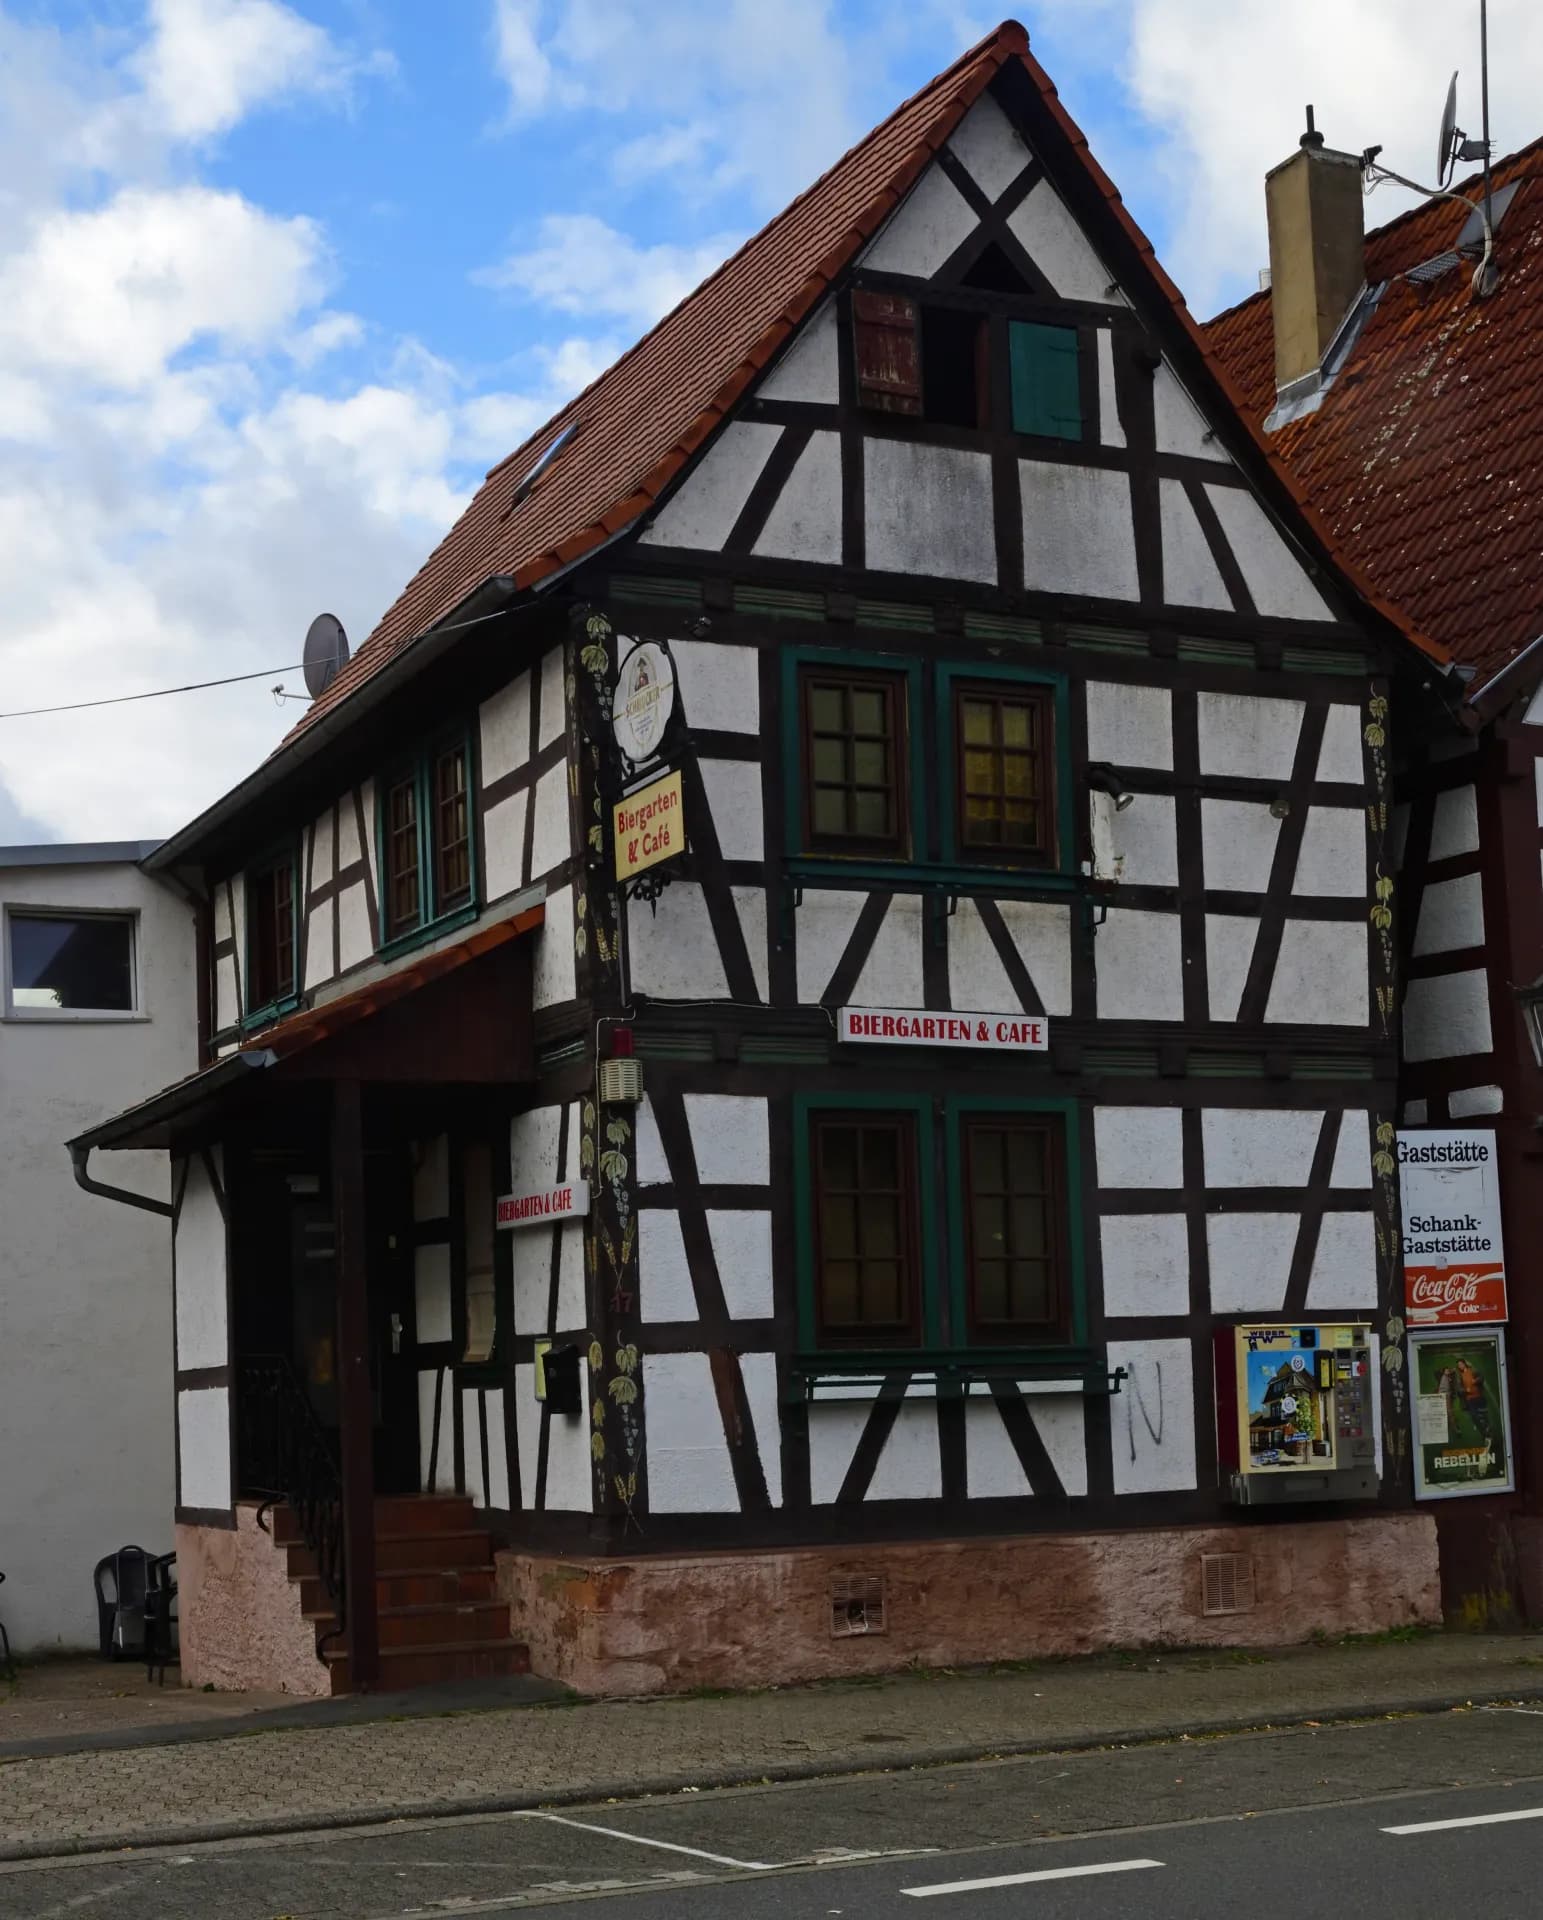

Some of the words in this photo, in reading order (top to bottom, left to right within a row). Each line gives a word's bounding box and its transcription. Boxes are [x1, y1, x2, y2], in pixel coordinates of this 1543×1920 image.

[618, 790, 677, 834] Biergarten
[628, 838, 639, 864] &
[642, 824, 670, 856] Café
[849, 1014, 971, 1041] BIERGARTEN
[976, 1021, 990, 1042] &
[996, 1022, 1042, 1044] CAFE
[1396, 1140, 1488, 1163] Gaststätte
[498, 1195, 543, 1222] BIERGARTEN
[544, 1193, 550, 1213] &
[552, 1188, 572, 1213] CAFE
[1409, 1214, 1482, 1233] Schank-
[1403, 1235, 1491, 1254] Gaststätte
[1412, 1273, 1478, 1303] Coca-Cola
[1458, 1302, 1480, 1314] Coke
